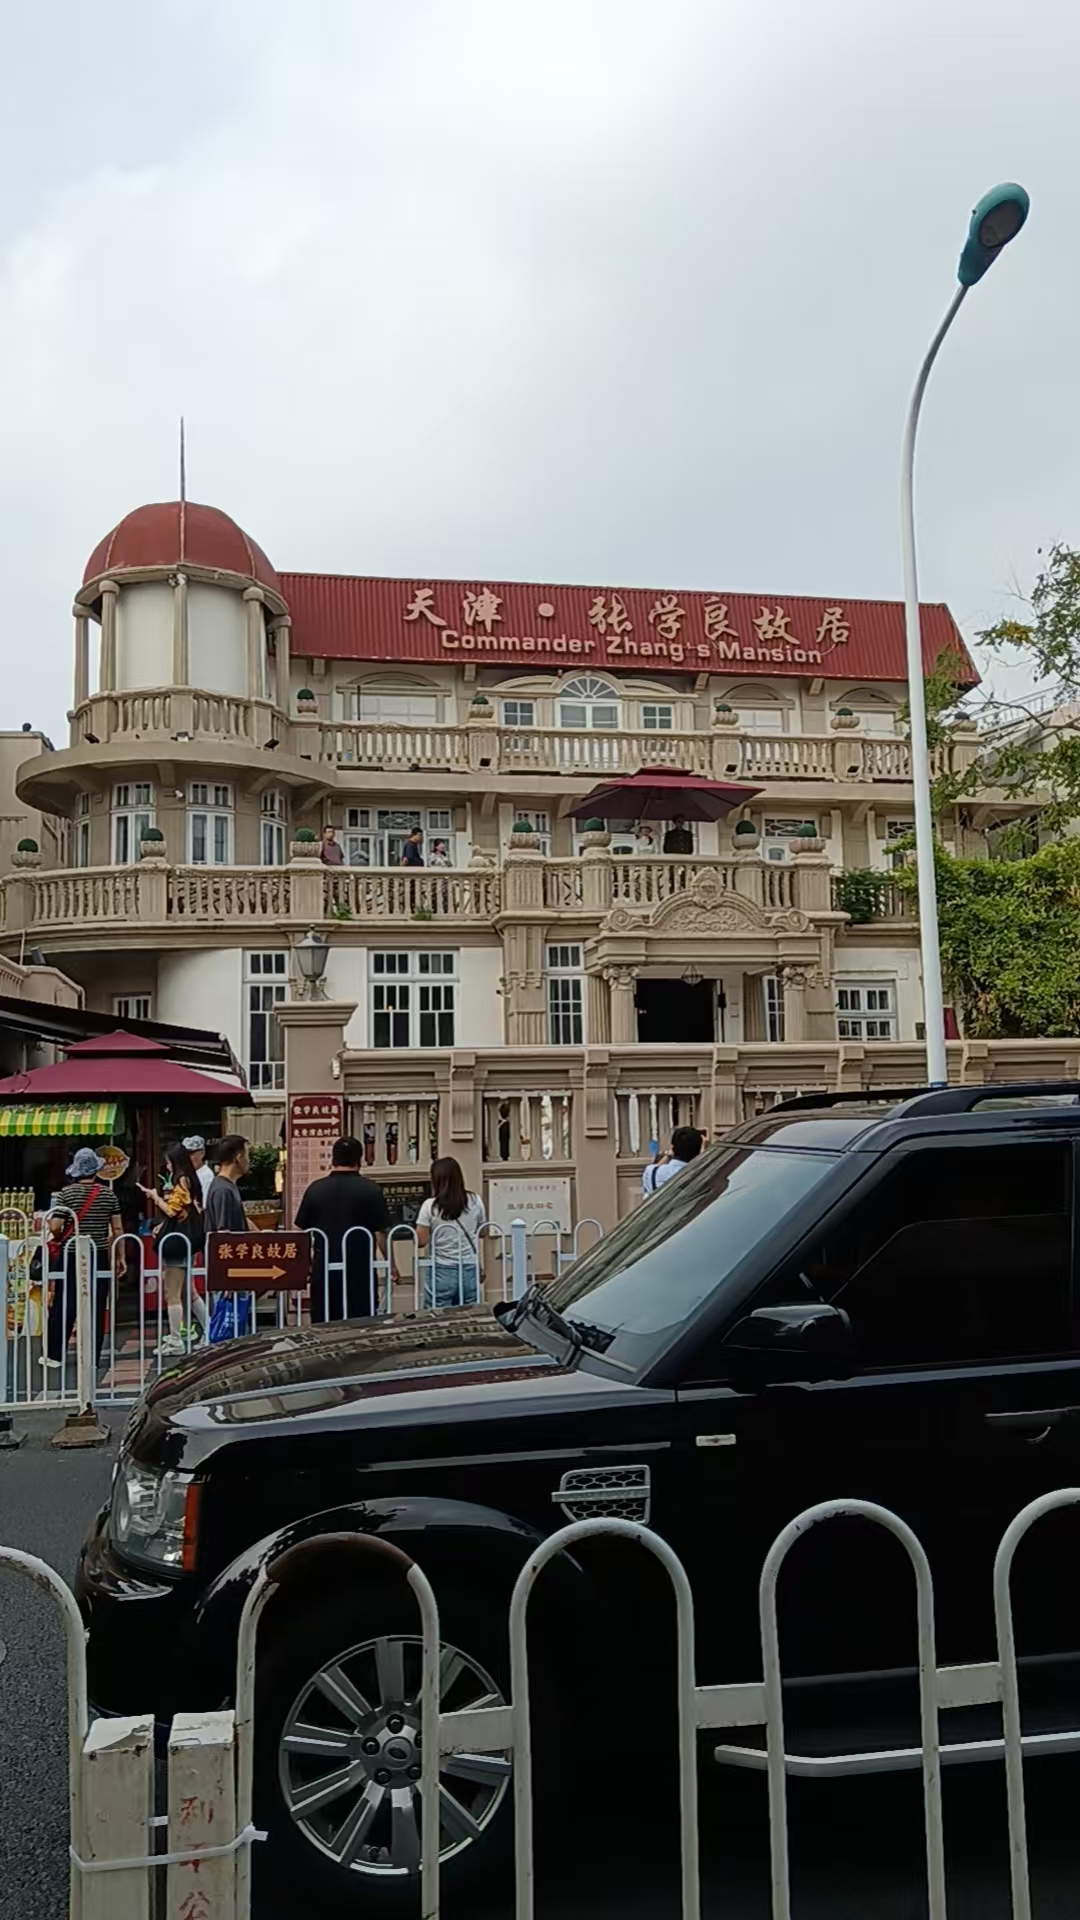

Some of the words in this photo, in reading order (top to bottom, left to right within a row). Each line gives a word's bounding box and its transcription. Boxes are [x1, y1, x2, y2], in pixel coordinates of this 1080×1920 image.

[440, 629, 596, 654] Commander
[605, 635, 711, 662] Zhang's
[719, 641, 823, 664] Mansion
[218, 1242, 298, 1260] 张学良故居
